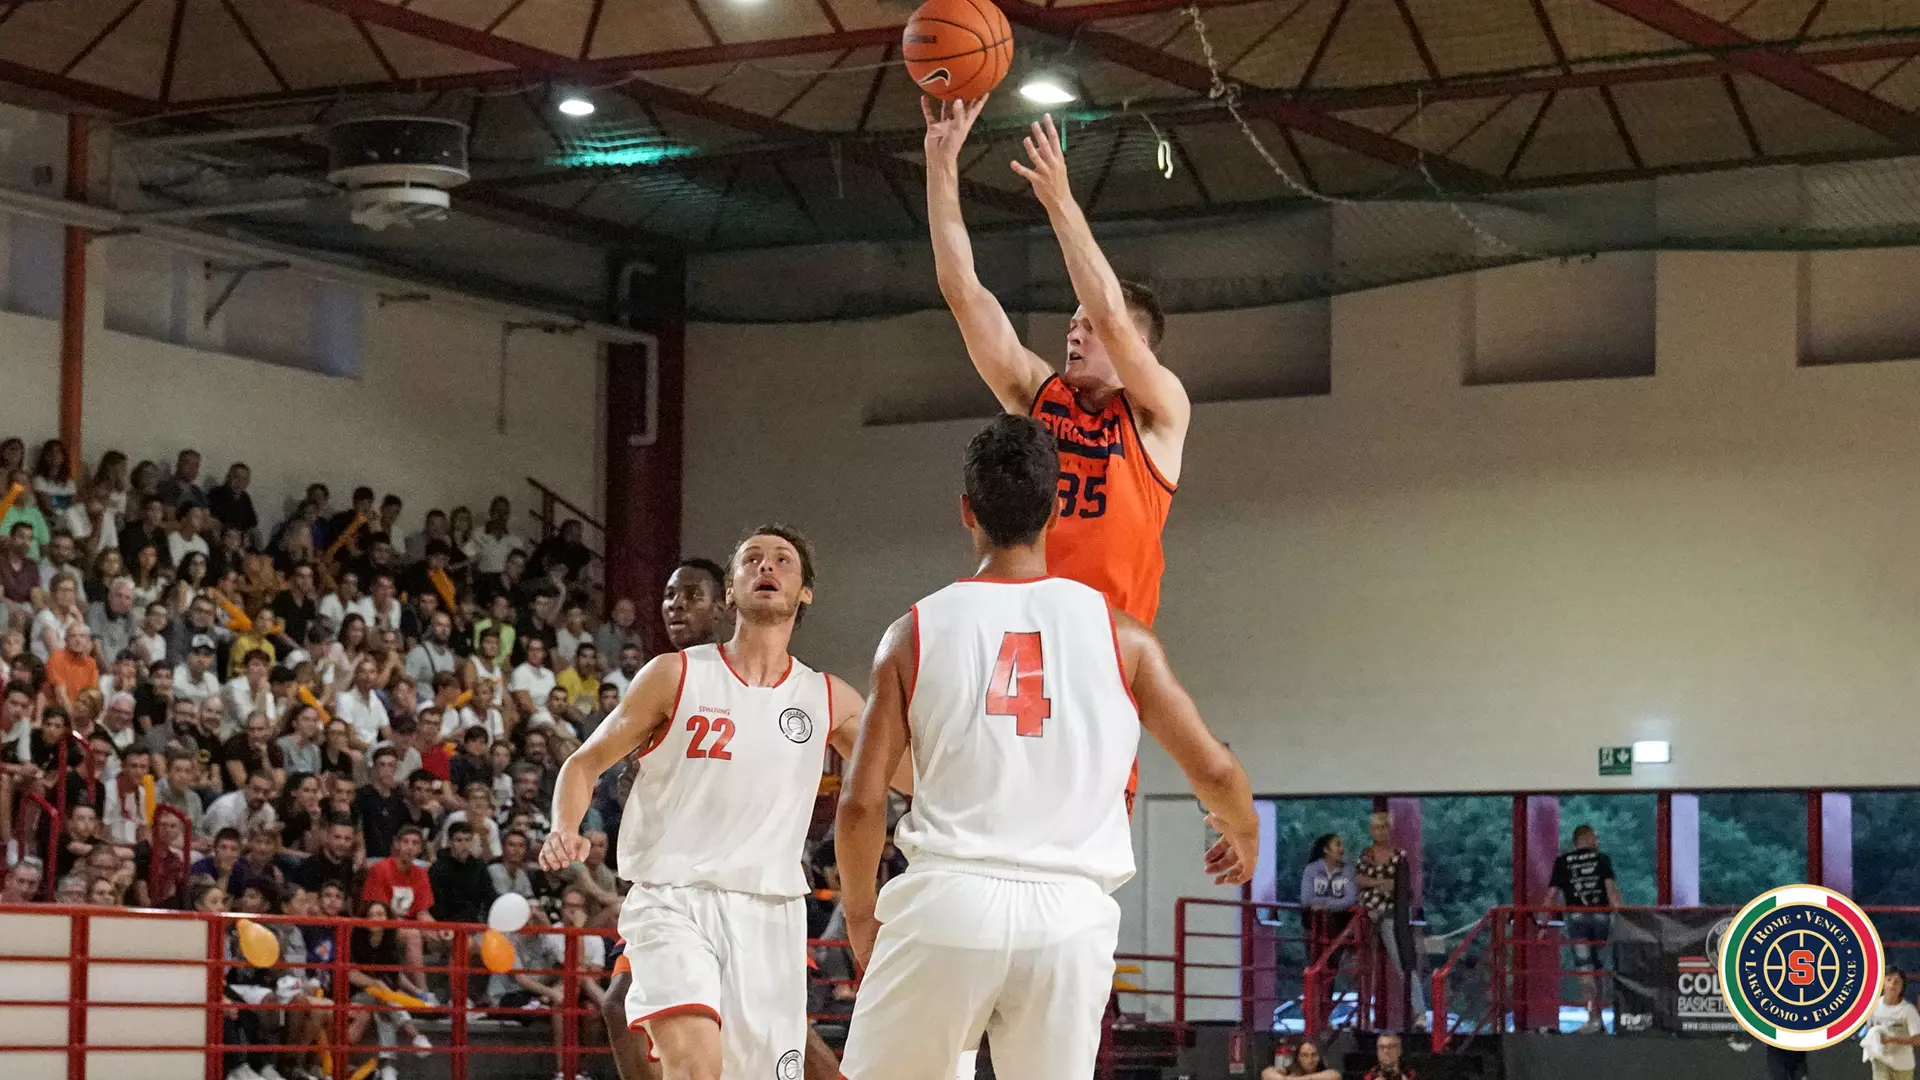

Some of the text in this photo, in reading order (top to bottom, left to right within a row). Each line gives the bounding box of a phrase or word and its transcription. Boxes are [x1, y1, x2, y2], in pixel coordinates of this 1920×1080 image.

[1057, 471, 1107, 519] 35
[986, 631, 1051, 737] 4
[698, 705, 731, 715] SPALDING
[686, 715, 735, 760] 22
